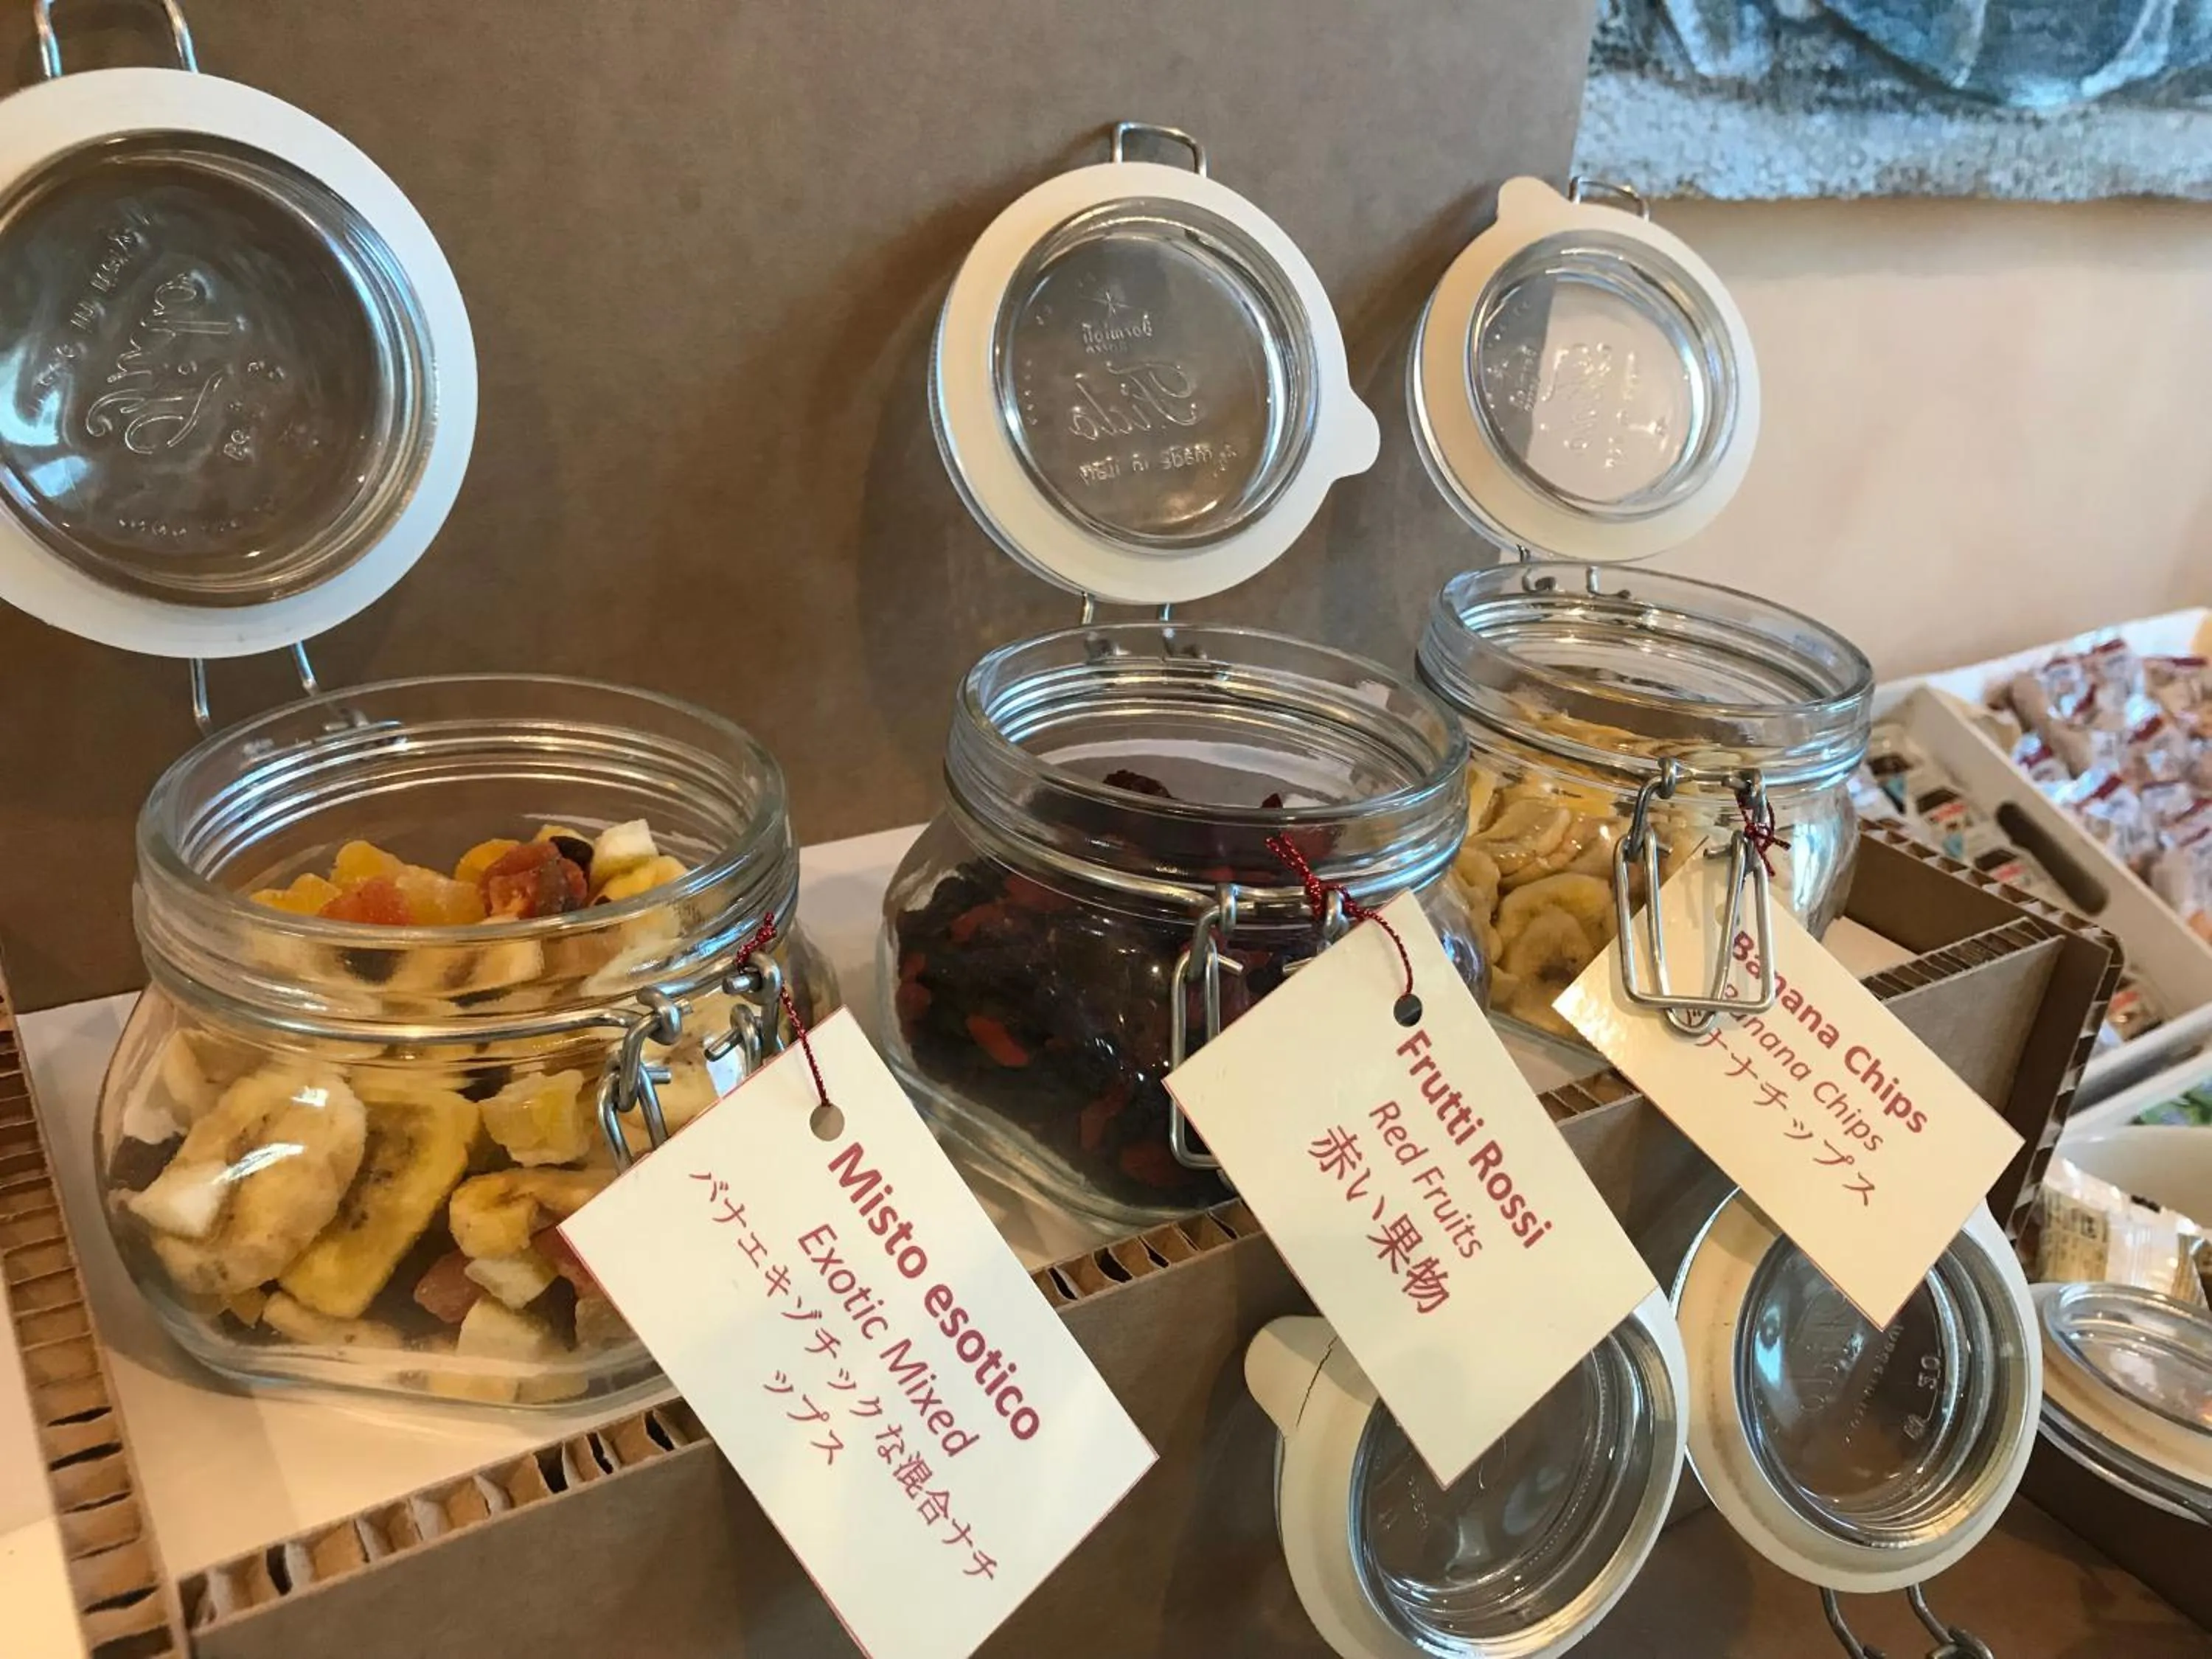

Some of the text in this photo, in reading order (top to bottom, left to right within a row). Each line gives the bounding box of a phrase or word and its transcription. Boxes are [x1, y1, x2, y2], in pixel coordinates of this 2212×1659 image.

[1369, 1101, 1484, 1259] Red Fruits
[1397, 1029, 1553, 1249] Frutti Rossi
[1813, 1081, 1884, 1152] Chips
[1844, 1045, 1928, 1133] Chips
[827, 1141, 1040, 1441] Misto esotico
[1307, 1127, 1450, 1315] 赤い果物
[798, 1223, 981, 1457] Exotic Mixed
